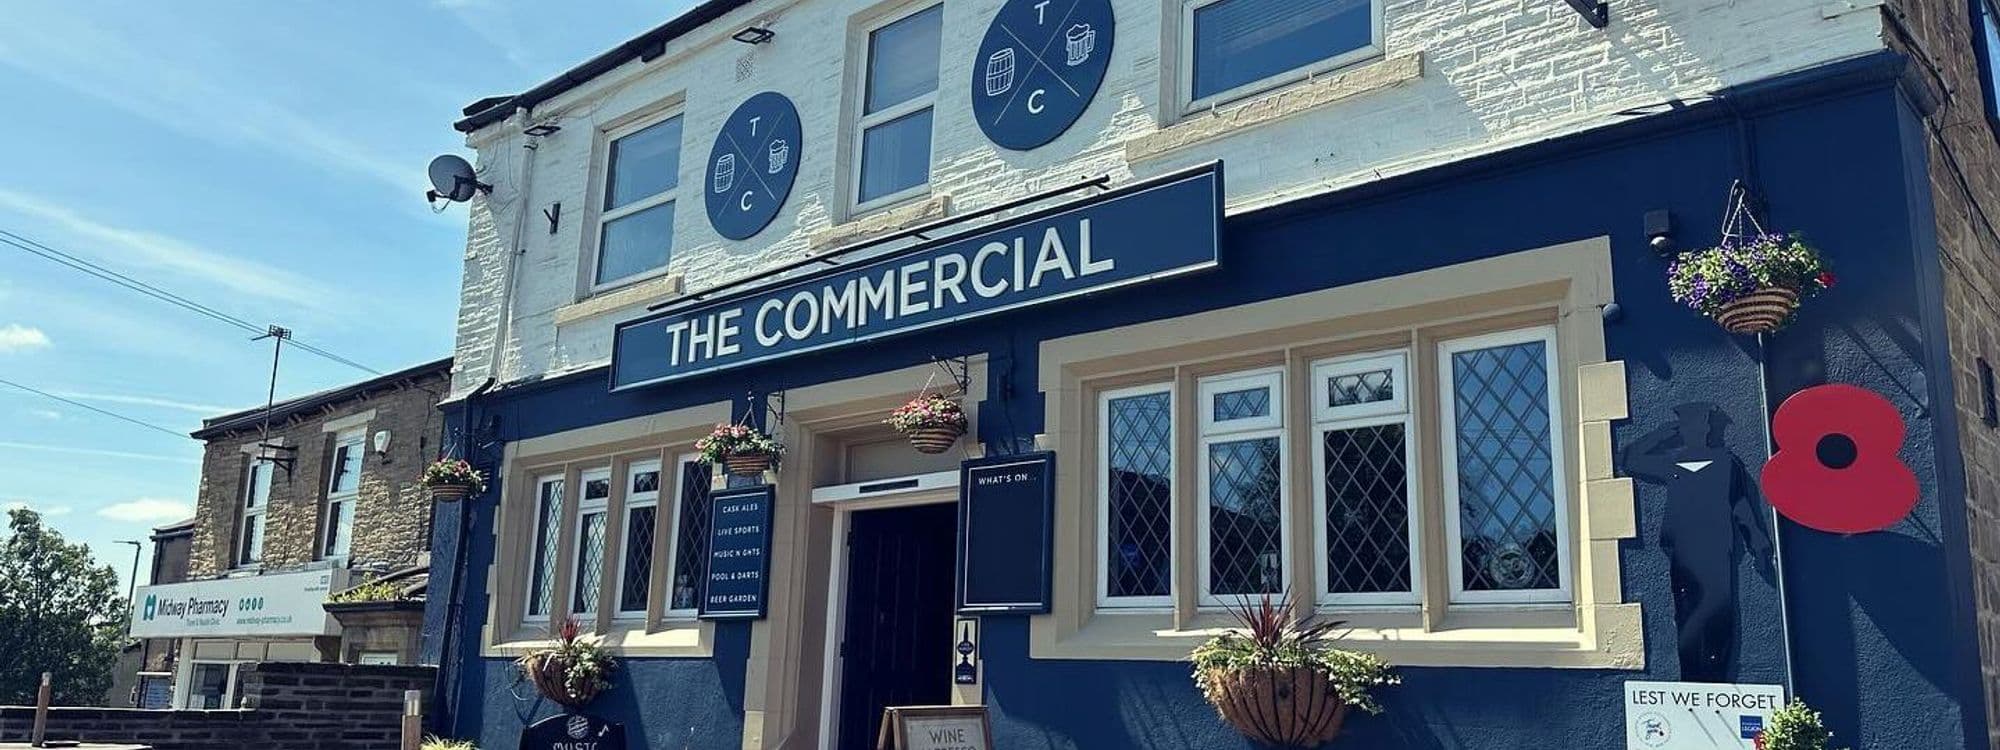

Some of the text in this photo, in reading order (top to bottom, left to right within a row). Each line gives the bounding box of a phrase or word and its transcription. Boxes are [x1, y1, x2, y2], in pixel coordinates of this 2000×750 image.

[1034, 0, 1050, 25] T
[1027, 89, 1045, 114] C
[749, 116, 761, 137] T
[740, 190, 753, 211] C
[666, 218, 1115, 367] THE COMMERCIAL
[978, 475, 1012, 486] WHAT'S
[722, 503, 758, 514] CASK ALES
[717, 525, 760, 536] LIVE SPORTS
[713, 547, 760, 558] MUSIC NGHTS
[711, 572, 729, 581] POOL
[737, 570, 759, 580] DARTS
[710, 594, 758, 604] BEER GARDEN
[158, 597, 230, 619] Midway Pharmacy
[1632, 690, 1776, 709] LEST WE FORGET
[929, 728, 965, 743] WINE
